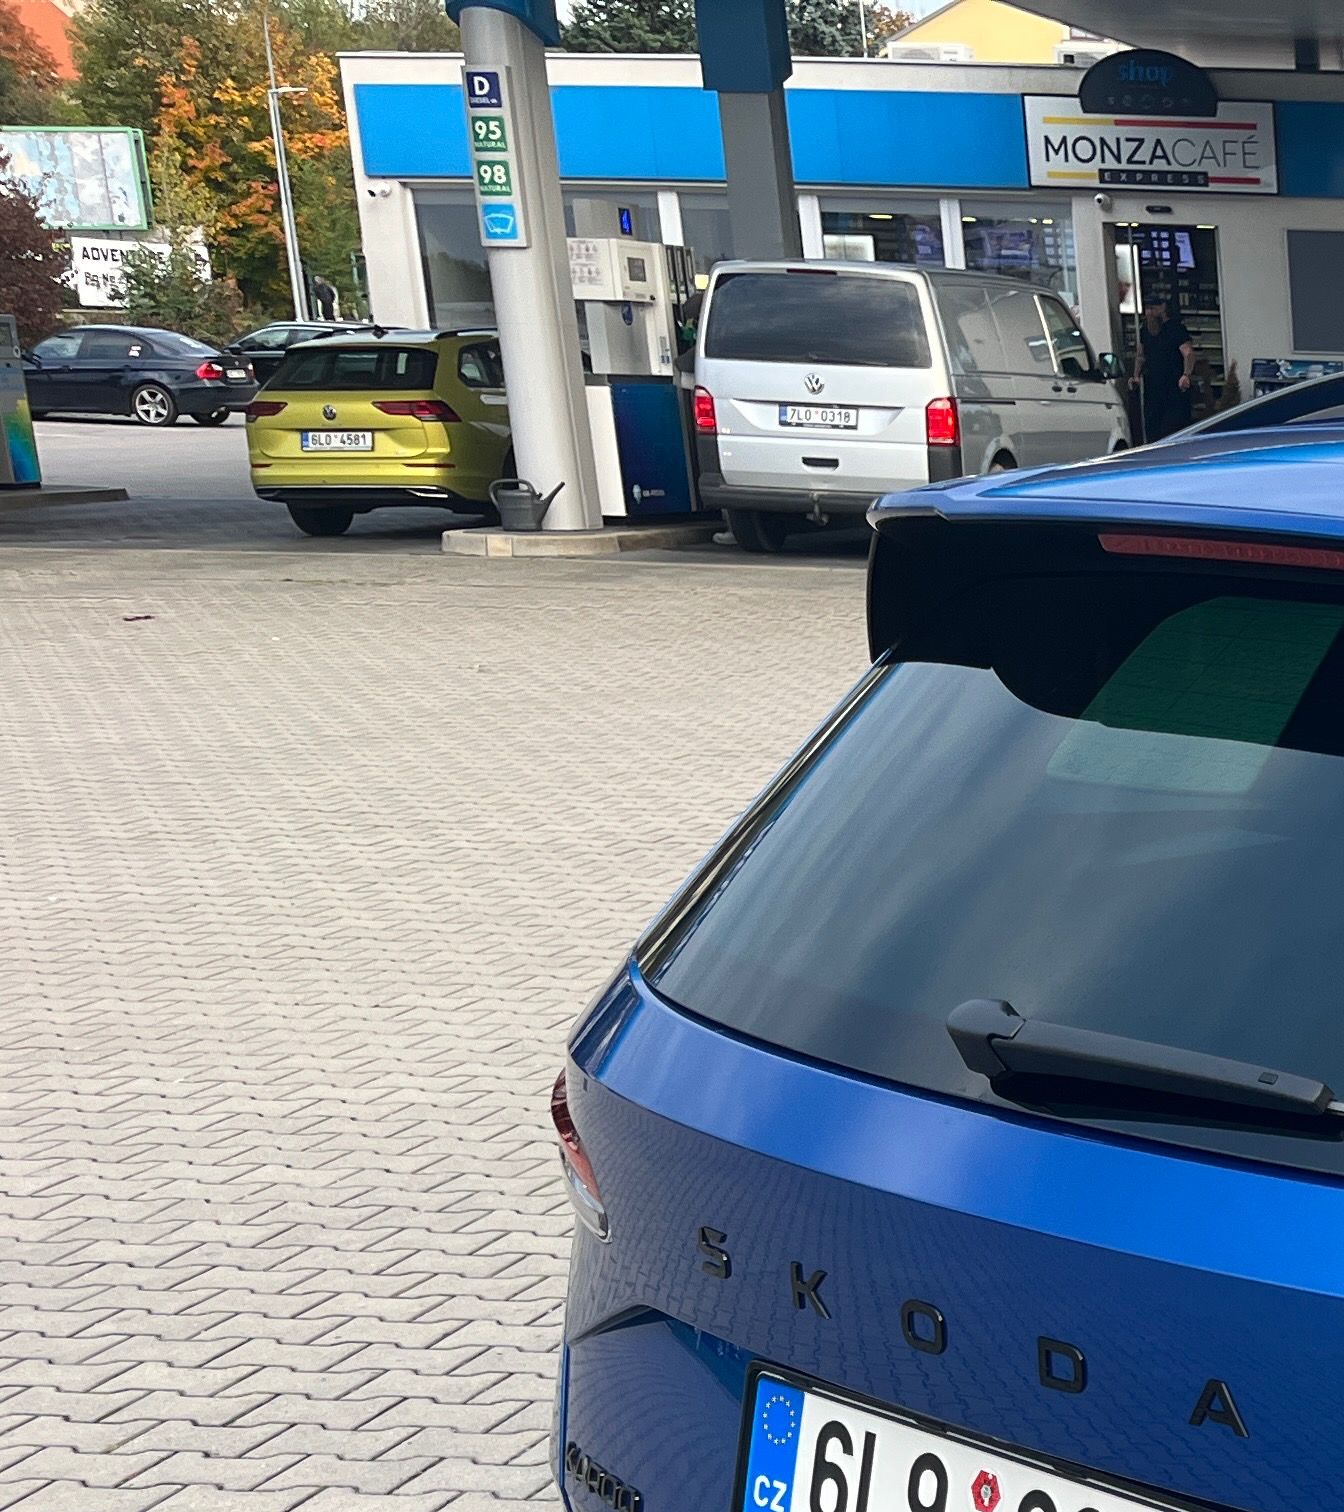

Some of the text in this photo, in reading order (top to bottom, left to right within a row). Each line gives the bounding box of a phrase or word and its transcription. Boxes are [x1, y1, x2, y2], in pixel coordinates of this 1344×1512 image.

[473, 76, 490, 96] D
[475, 121, 502, 140] 95
[1043, 135, 1261, 169] MONZACAFÉ
[480, 165, 507, 184] 98
[1103, 171, 1205, 185] EXPRESS
[820, 410, 851, 424] 0318
[339, 433, 367, 446] 4581
[700, 1226, 1250, 1439] SKODA
